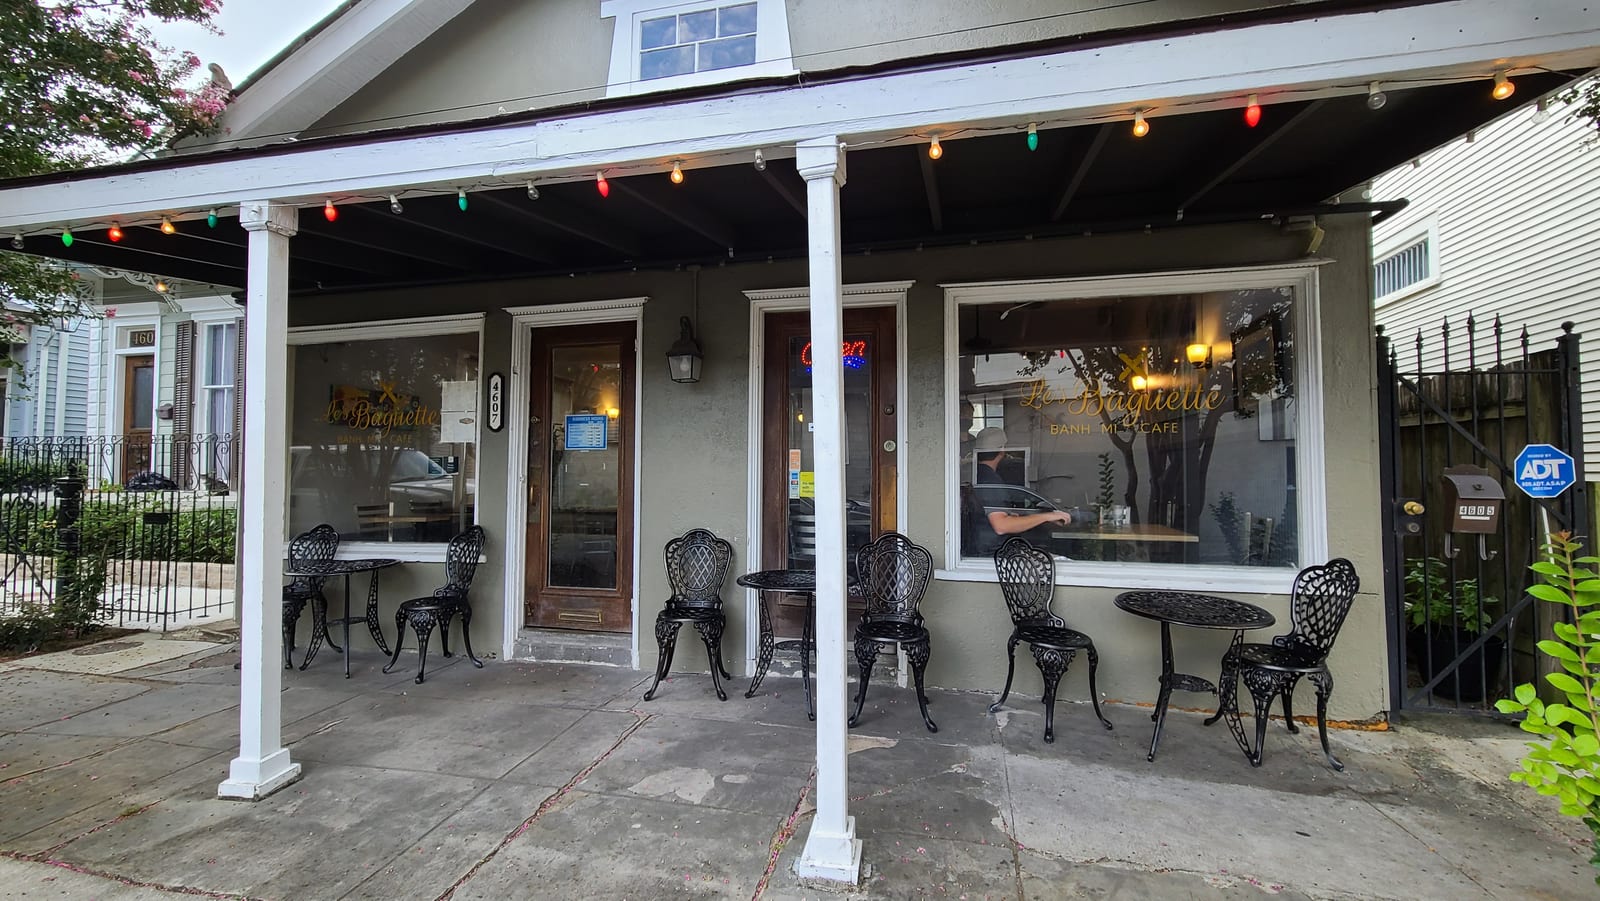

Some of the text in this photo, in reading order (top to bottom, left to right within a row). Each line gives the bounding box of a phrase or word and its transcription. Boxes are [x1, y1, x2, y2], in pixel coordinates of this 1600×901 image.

[1067, 377, 1226, 427] Baguette
[349, 400, 438, 438] Baguette
[1050, 422, 1179, 435] BANH MI CAFE
[1520, 458, 1566, 480] ADT
[1459, 506, 1495, 515] 4605
